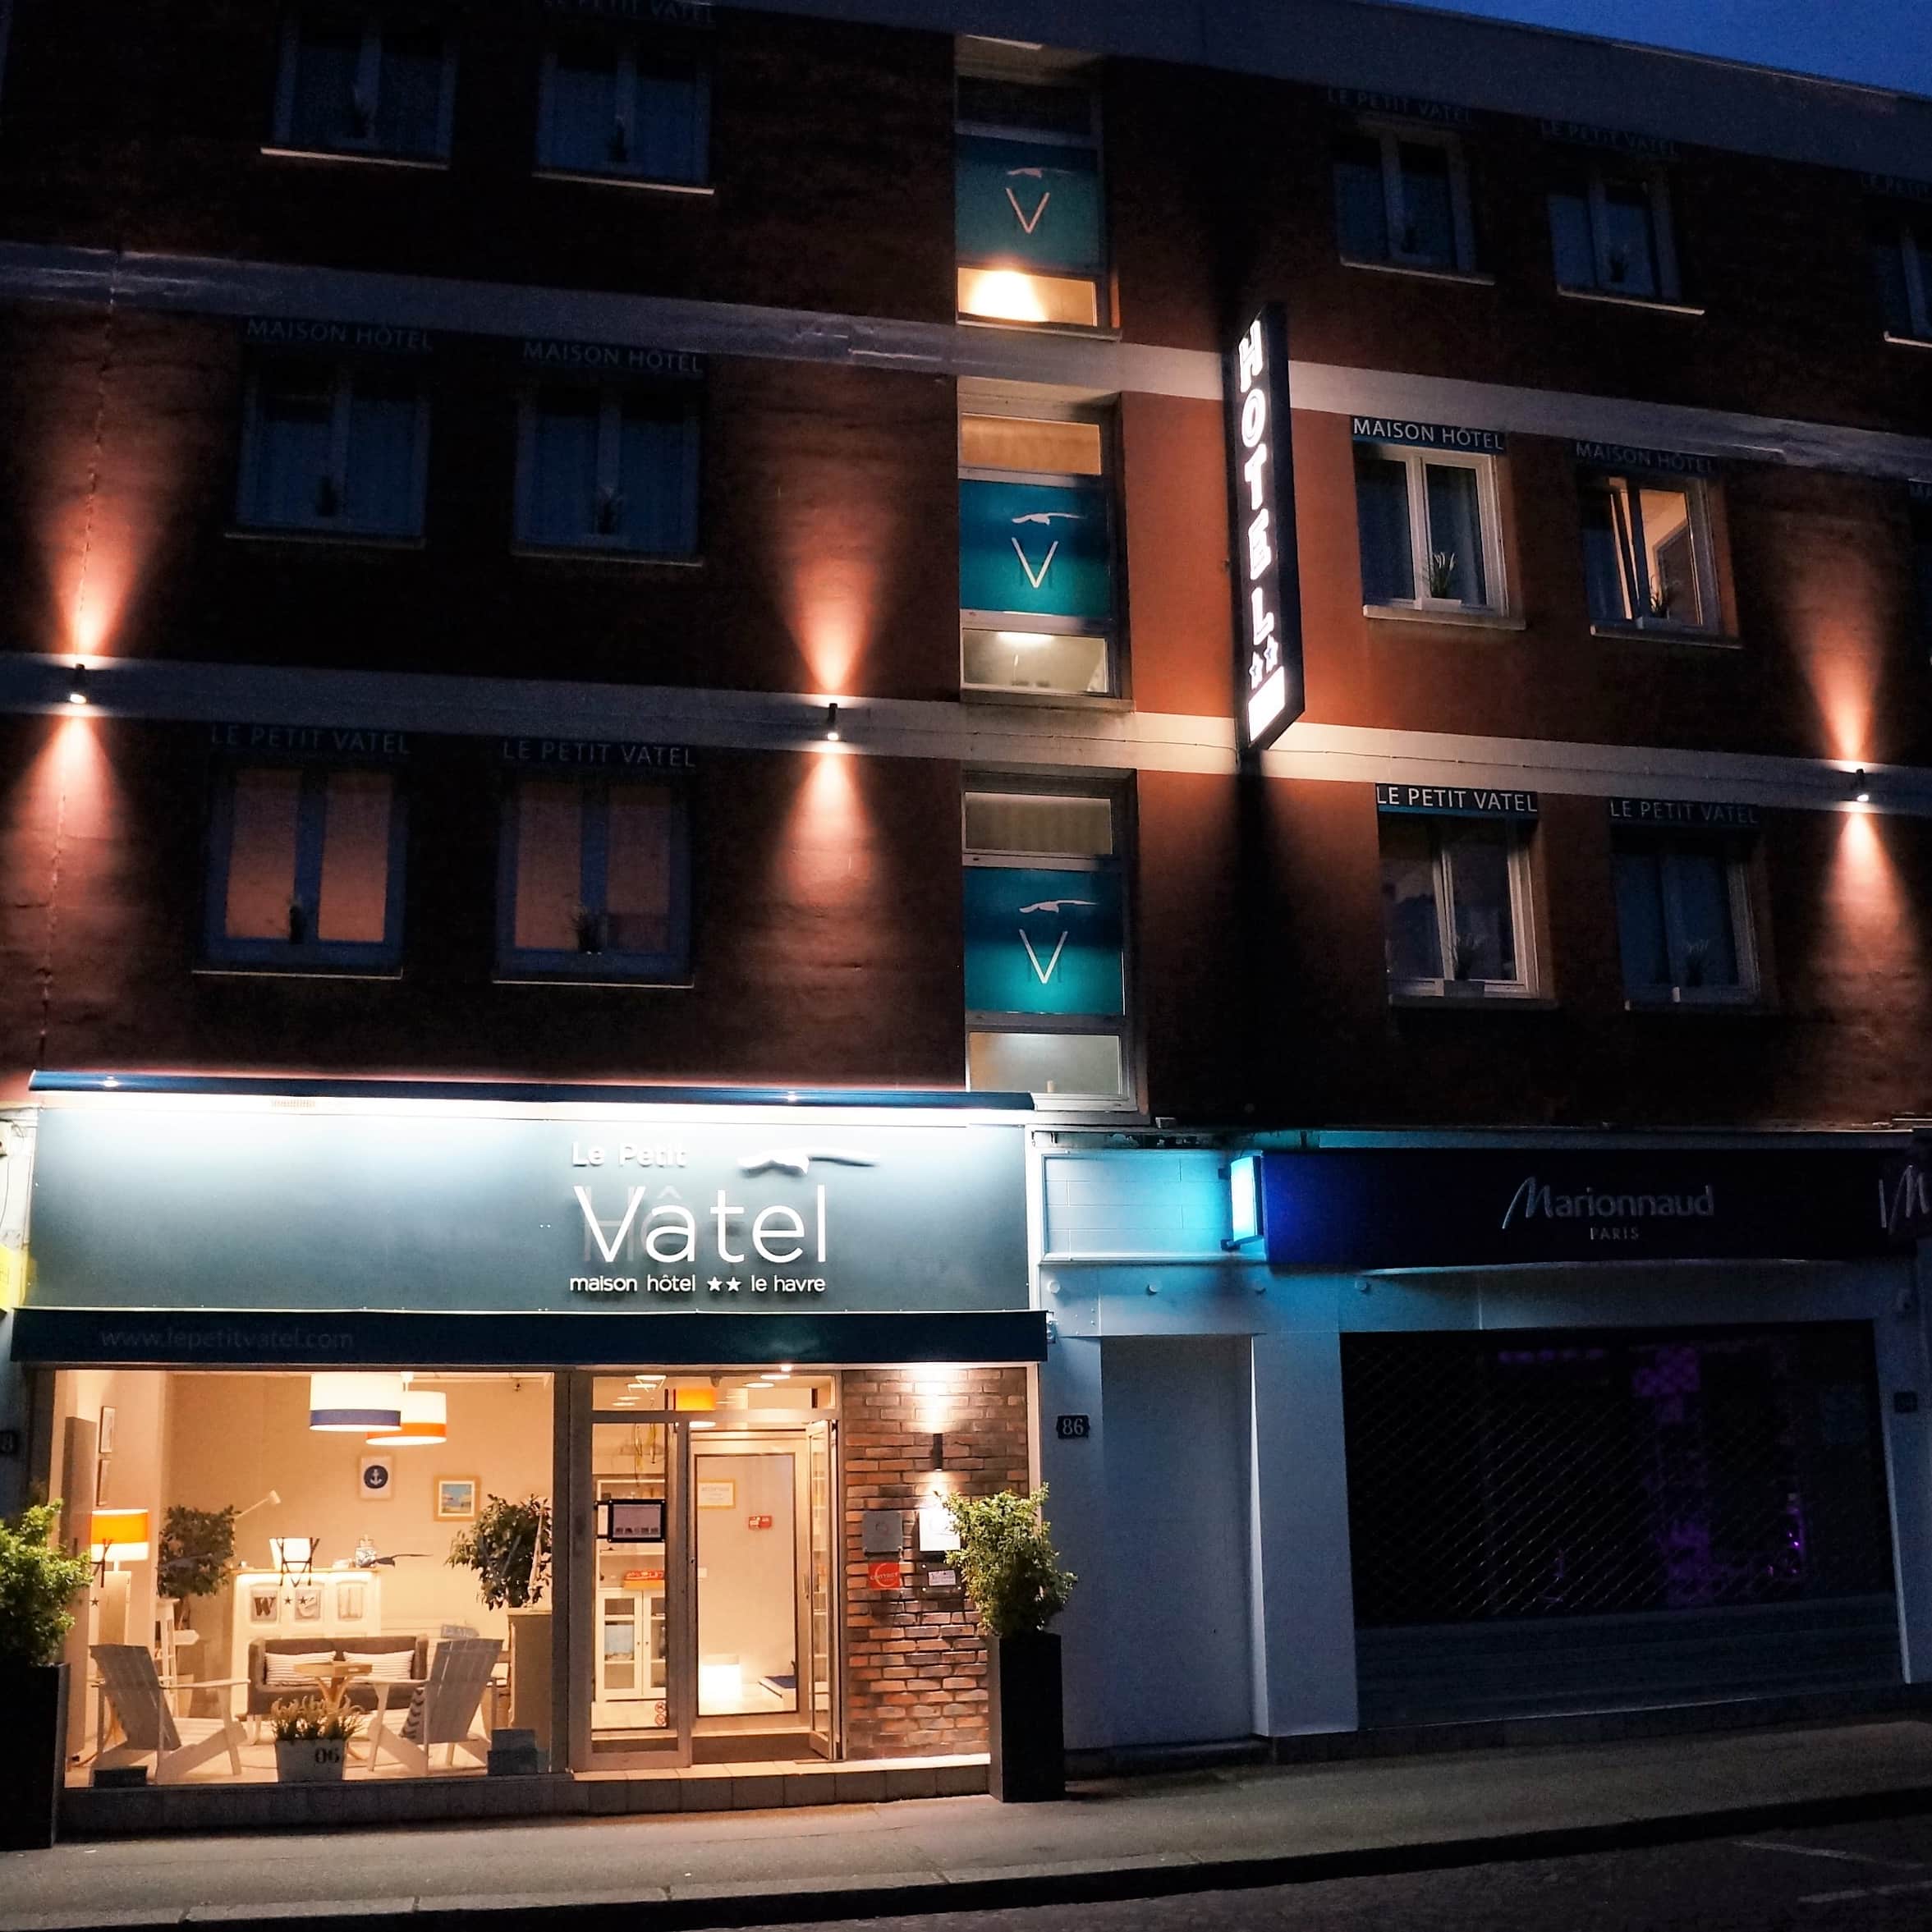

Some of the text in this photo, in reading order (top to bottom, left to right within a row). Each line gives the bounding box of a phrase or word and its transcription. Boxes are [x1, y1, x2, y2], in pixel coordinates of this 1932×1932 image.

[1005, 187, 1050, 234] V
[248, 319, 346, 342] MAISON
[523, 341, 619, 366] MAISON
[1353, 419, 1435, 443] MAISON
[1576, 442, 1651, 466] MAISON
[1011, 536, 1058, 589] V
[211, 722, 412, 755] LE PETIT VATEL
[502, 741, 696, 769] LE PETIT VATEL
[1376, 785, 1538, 813] LE PETIT VATEL
[1610, 799, 1760, 824] LE PETIT VATEL
[1018, 929, 1068, 984] V
[572, 1142, 688, 1167] Le Petit
[1501, 1176, 1715, 1231] Marionnaud
[1590, 1227, 1641, 1241] PARIS
[570, 1273, 826, 1292] maison hôtel le havre
[100, 1328, 354, 1350] www.lepetitvatel.com
[1062, 1418, 1084, 1435] 86
